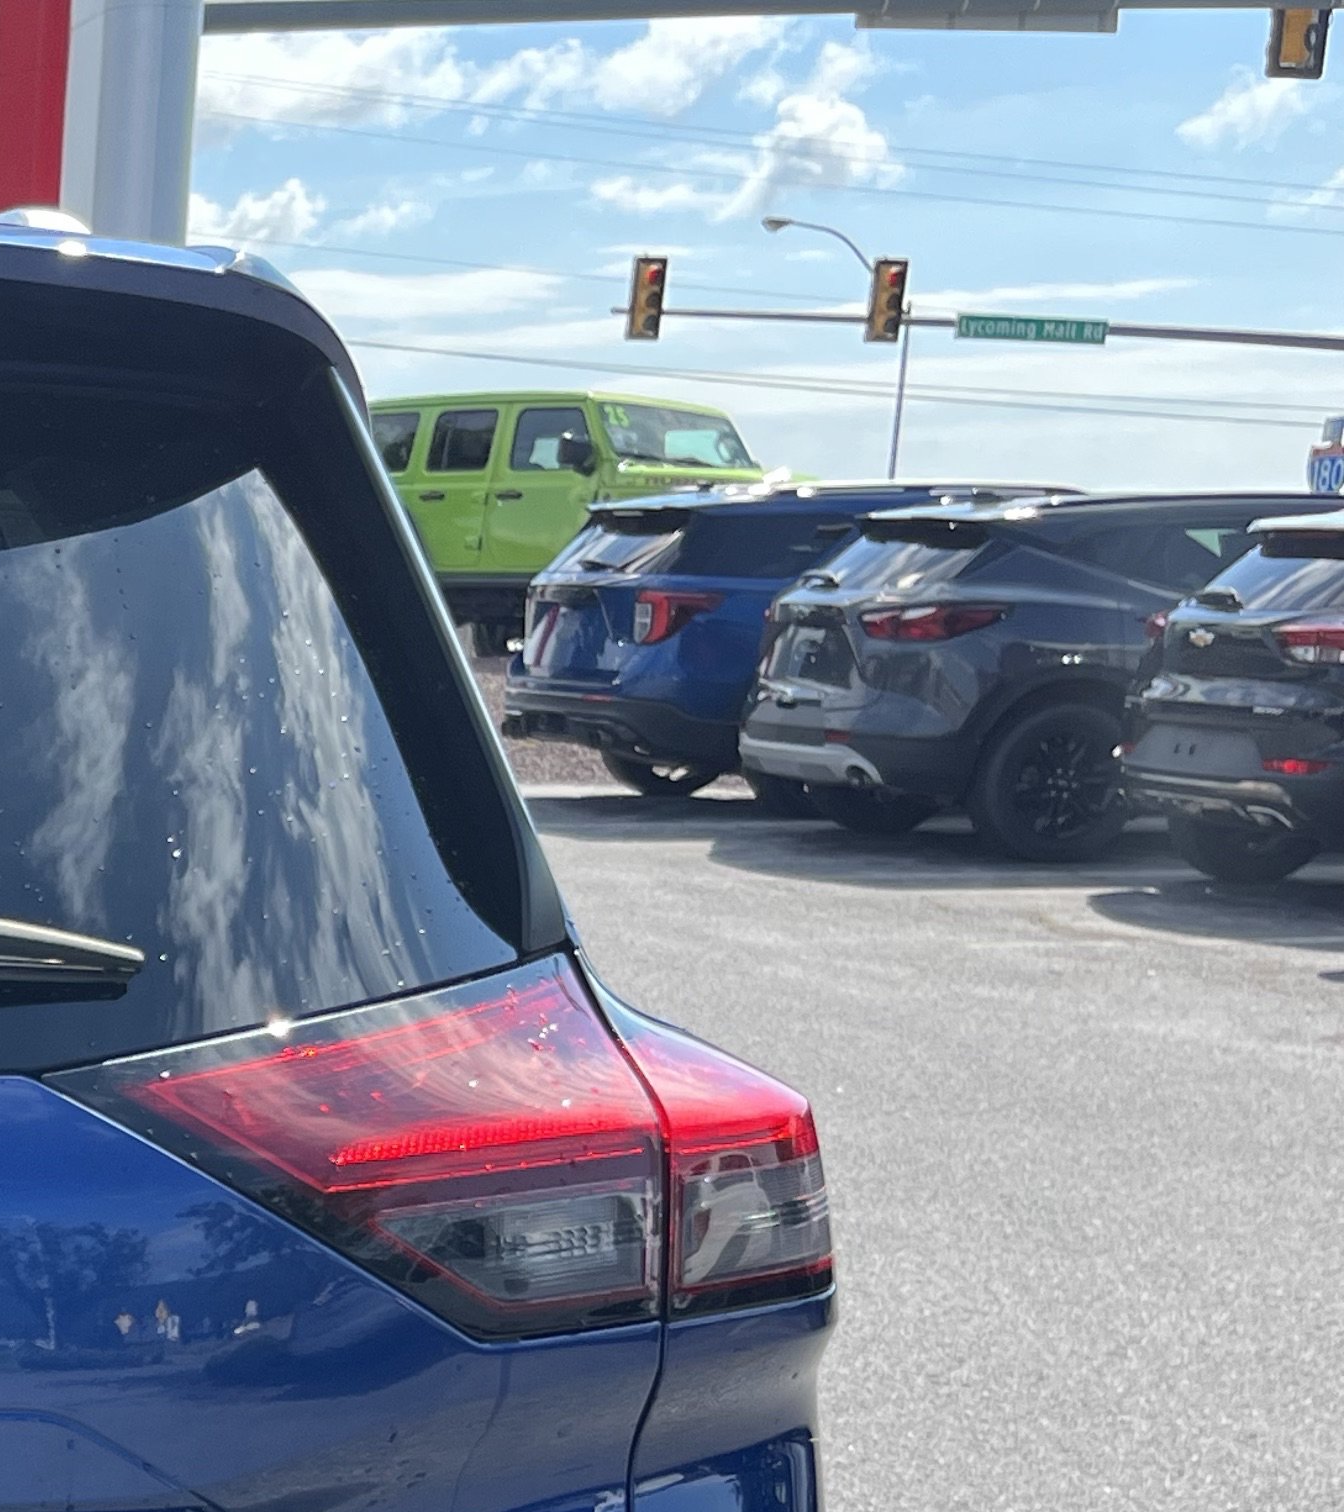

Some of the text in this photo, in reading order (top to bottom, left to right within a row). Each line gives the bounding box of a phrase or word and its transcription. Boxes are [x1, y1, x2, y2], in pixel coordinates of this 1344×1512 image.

[962, 319, 1104, 340] Lycoming Mall Rd
[1313, 458, 1344, 491] 180
